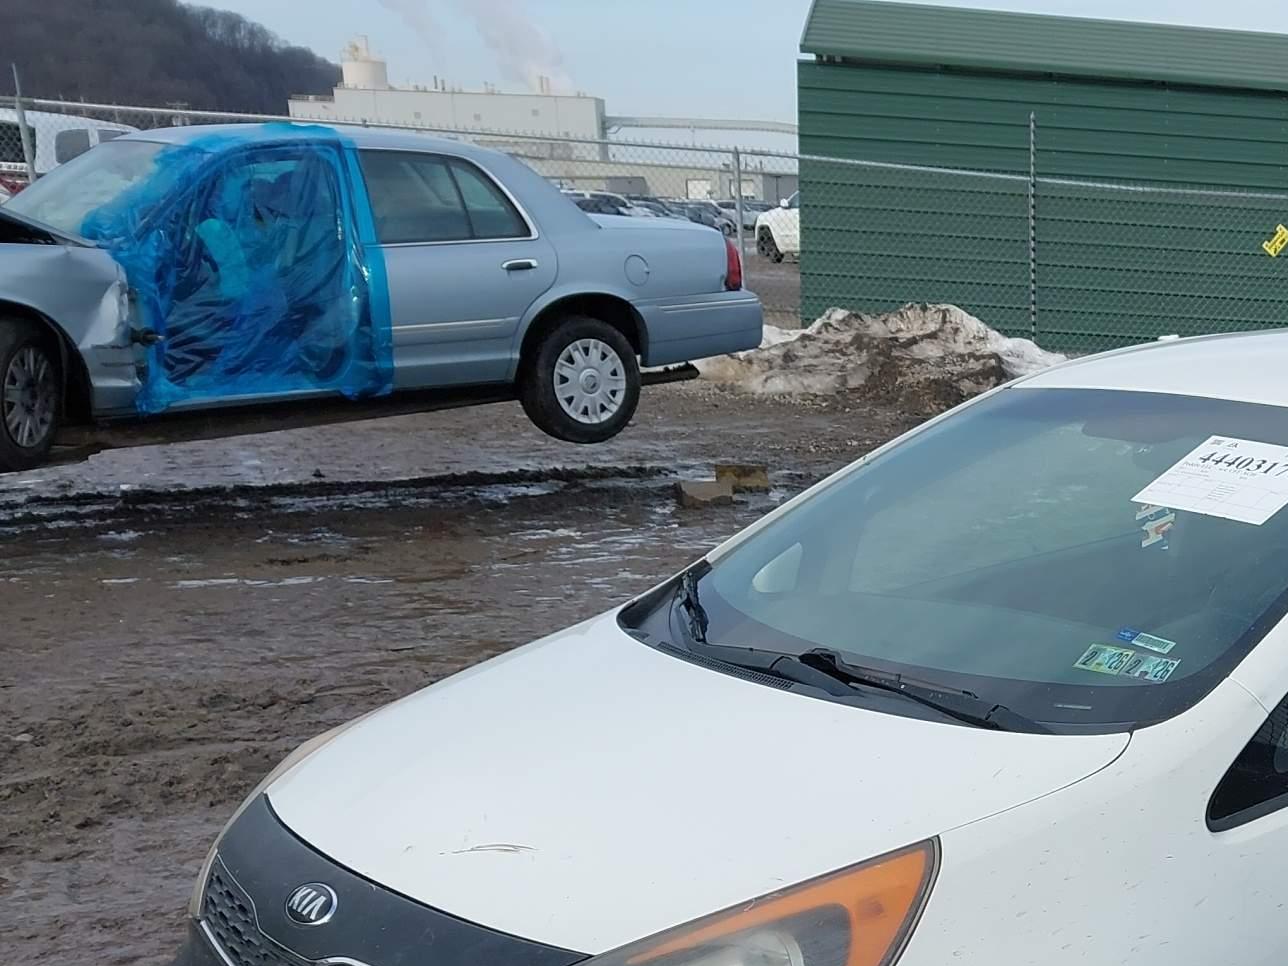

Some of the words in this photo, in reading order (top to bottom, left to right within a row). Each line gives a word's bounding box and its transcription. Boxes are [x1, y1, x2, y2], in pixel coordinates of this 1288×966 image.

[1081, 650, 1098, 666] 2
[1125, 659, 1142, 675] 2
[288, 886, 327, 921] KIA
